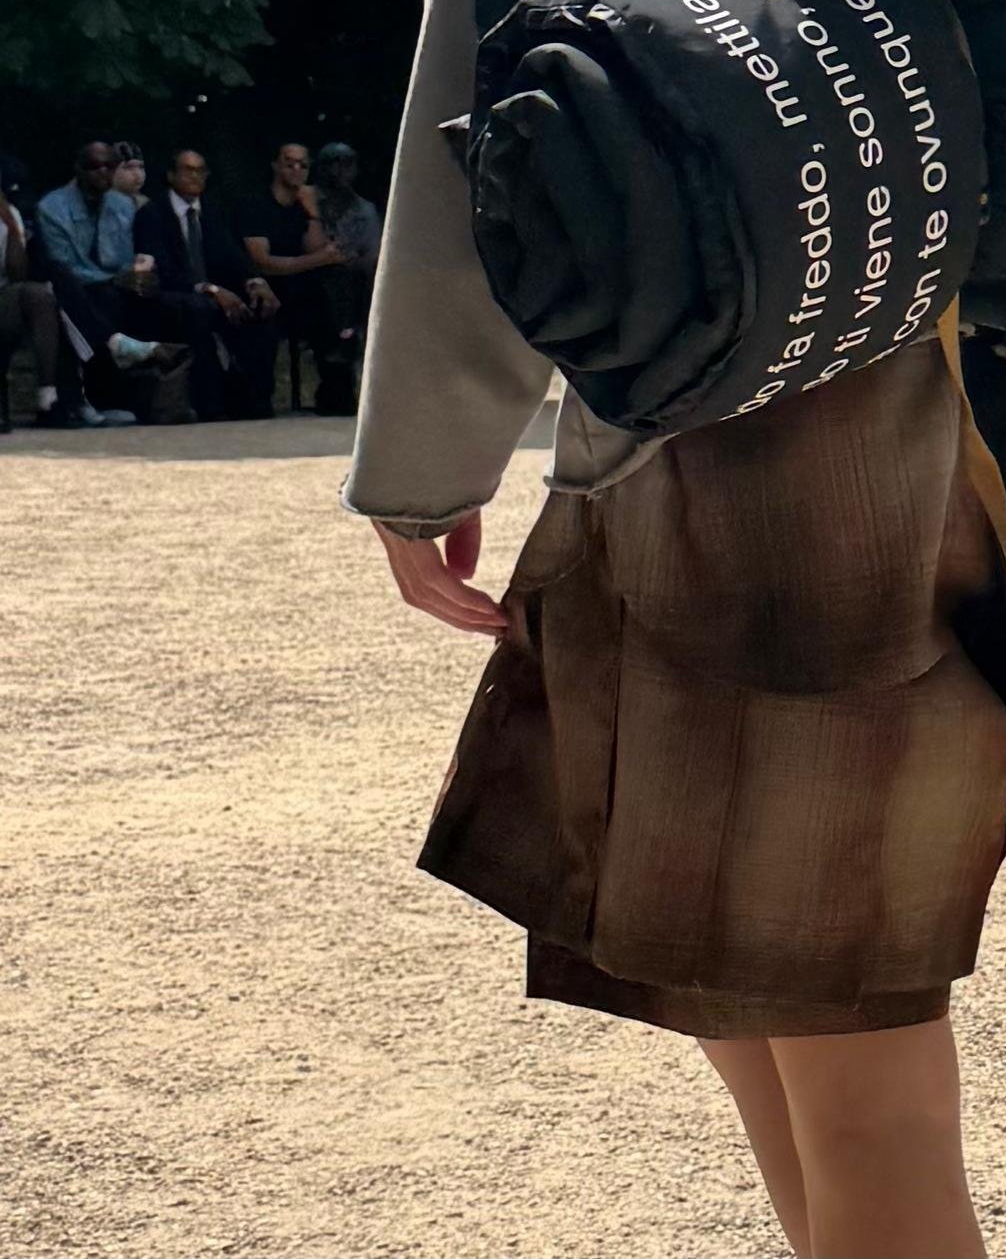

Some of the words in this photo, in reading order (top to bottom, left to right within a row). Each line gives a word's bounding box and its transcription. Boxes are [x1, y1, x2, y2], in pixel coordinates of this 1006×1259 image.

[796, 7, 885, 169] sonno,
[788, 143, 833, 325] freddo,
[853, 185, 894, 319] viene
[893, 268, 941, 342] con
[917, 208, 949, 260] te
[766, 330, 816, 374] fa
[833, 326, 871, 353] ti
